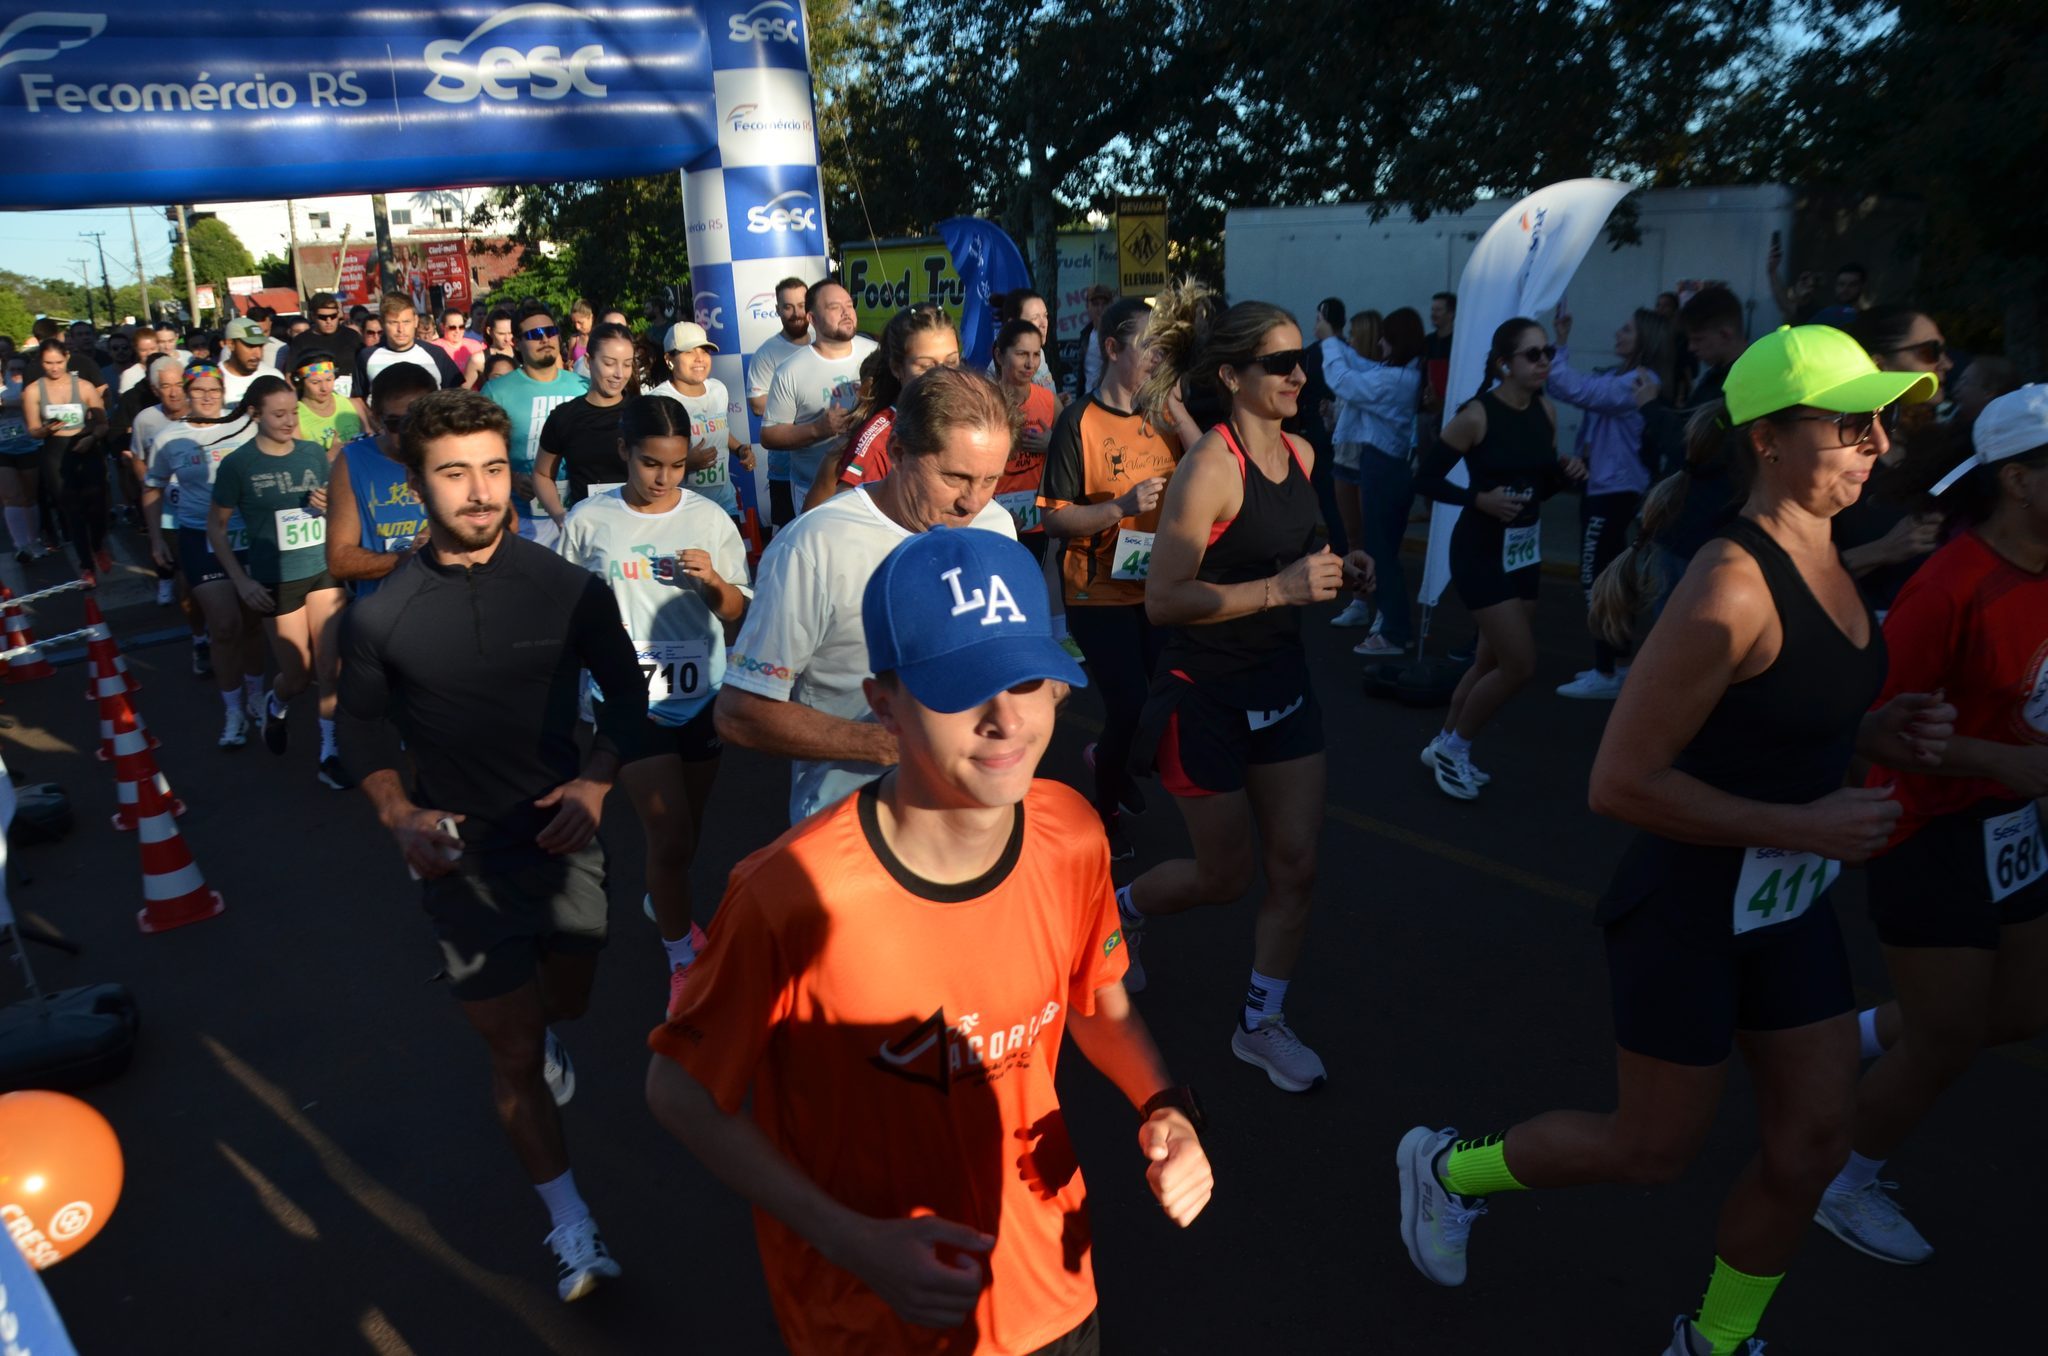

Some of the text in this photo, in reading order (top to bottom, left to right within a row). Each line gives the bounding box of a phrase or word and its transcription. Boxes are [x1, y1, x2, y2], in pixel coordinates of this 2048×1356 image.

[728, 12, 799, 45] Sesc
[423, 38, 607, 104] Sesc
[19, 70, 367, 113] Fecomércio RS
[746, 205, 817, 234] Sesc
[1120, 201, 1166, 213] DEVAGAR
[708, 218, 724, 231] RS
[850, 258, 912, 311] Food
[1123, 271, 1165, 287] ELEVADA
[728, 401, 742, 414] RS
[695, 461, 726, 485] 561
[286, 519, 322, 546] 510
[376, 522, 417, 538] NUTRI
[1580, 515, 1607, 584] GROWTH
[941, 566, 1027, 626] LA
[638, 662, 699, 695] 710
[1747, 858, 1828, 919] 411
[1421, 1180, 1435, 1223] FILA
